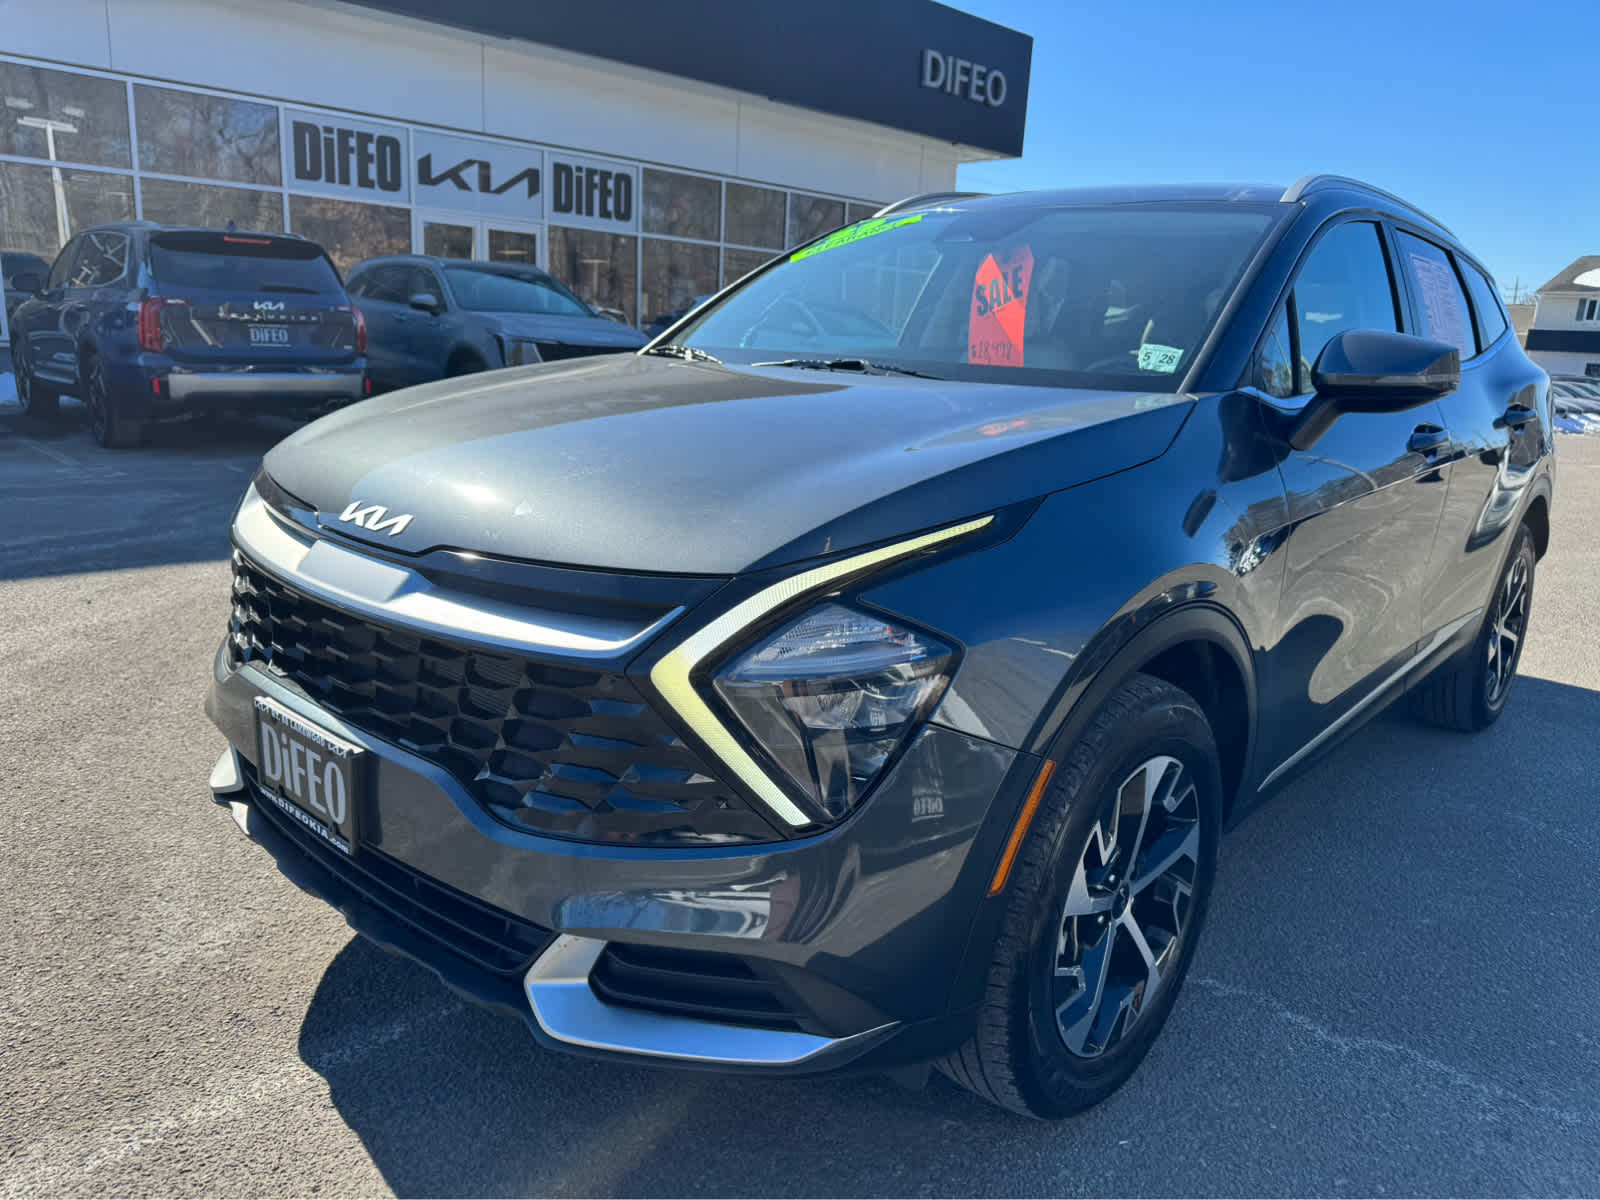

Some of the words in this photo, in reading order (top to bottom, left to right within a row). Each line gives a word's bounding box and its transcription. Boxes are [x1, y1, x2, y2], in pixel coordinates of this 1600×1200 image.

[923, 48, 1007, 107] DIFEO
[292, 119, 401, 192] DiFEO
[417, 153, 540, 199] KIA
[553, 161, 632, 221] DiFEO
[975, 264, 1024, 317] SALE
[1142, 351, 1152, 361] 5
[1159, 353, 1176, 365] 28
[339, 500, 414, 536] KIA
[261, 721, 346, 825] DiFEO
